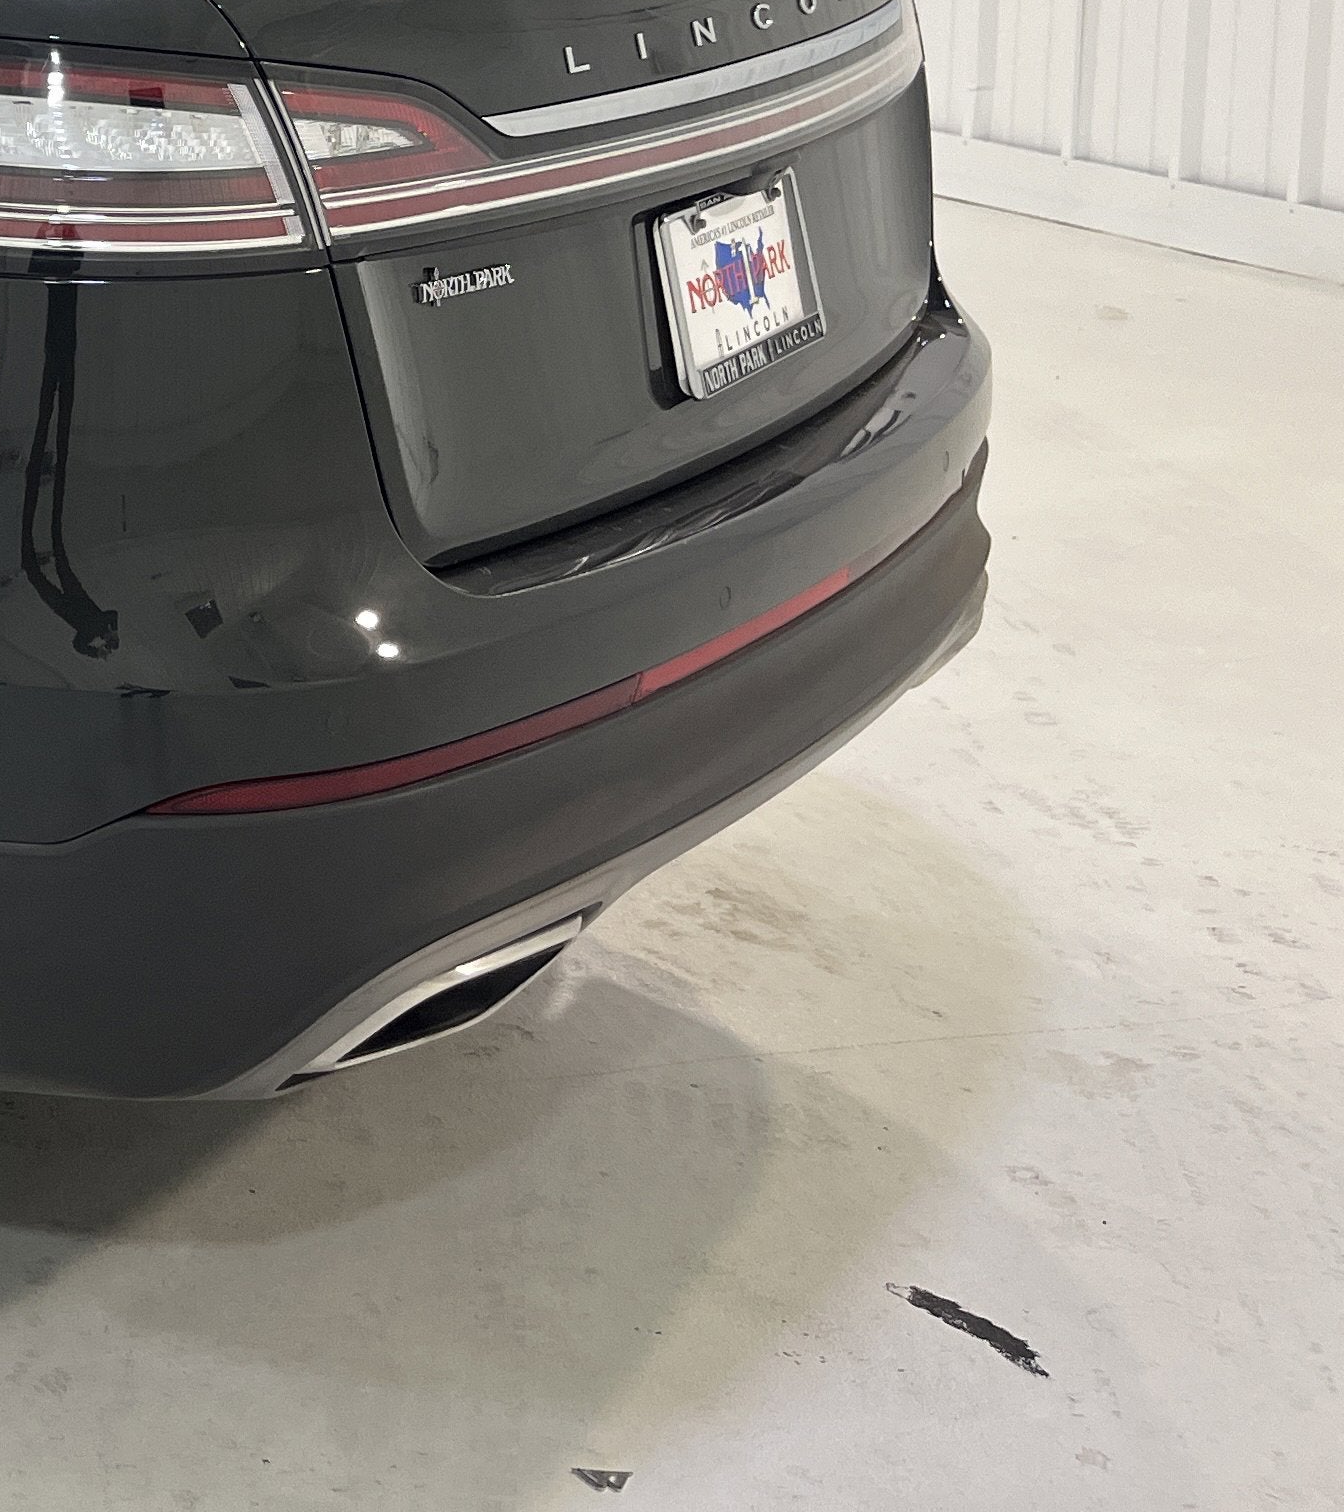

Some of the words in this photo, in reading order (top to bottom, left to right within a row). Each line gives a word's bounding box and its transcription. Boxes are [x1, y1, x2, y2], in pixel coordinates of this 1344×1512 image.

[419, 272, 473, 305] NORTH
[472, 263, 515, 292] PARK
[686, 259, 748, 314] NORTH
[750, 239, 791, 284] PARK
[704, 357, 739, 393] NORTH
[739, 343, 768, 376] PARK
[774, 318, 824, 355] LINCOLN
[725, 305, 790, 351] LINCOLN
